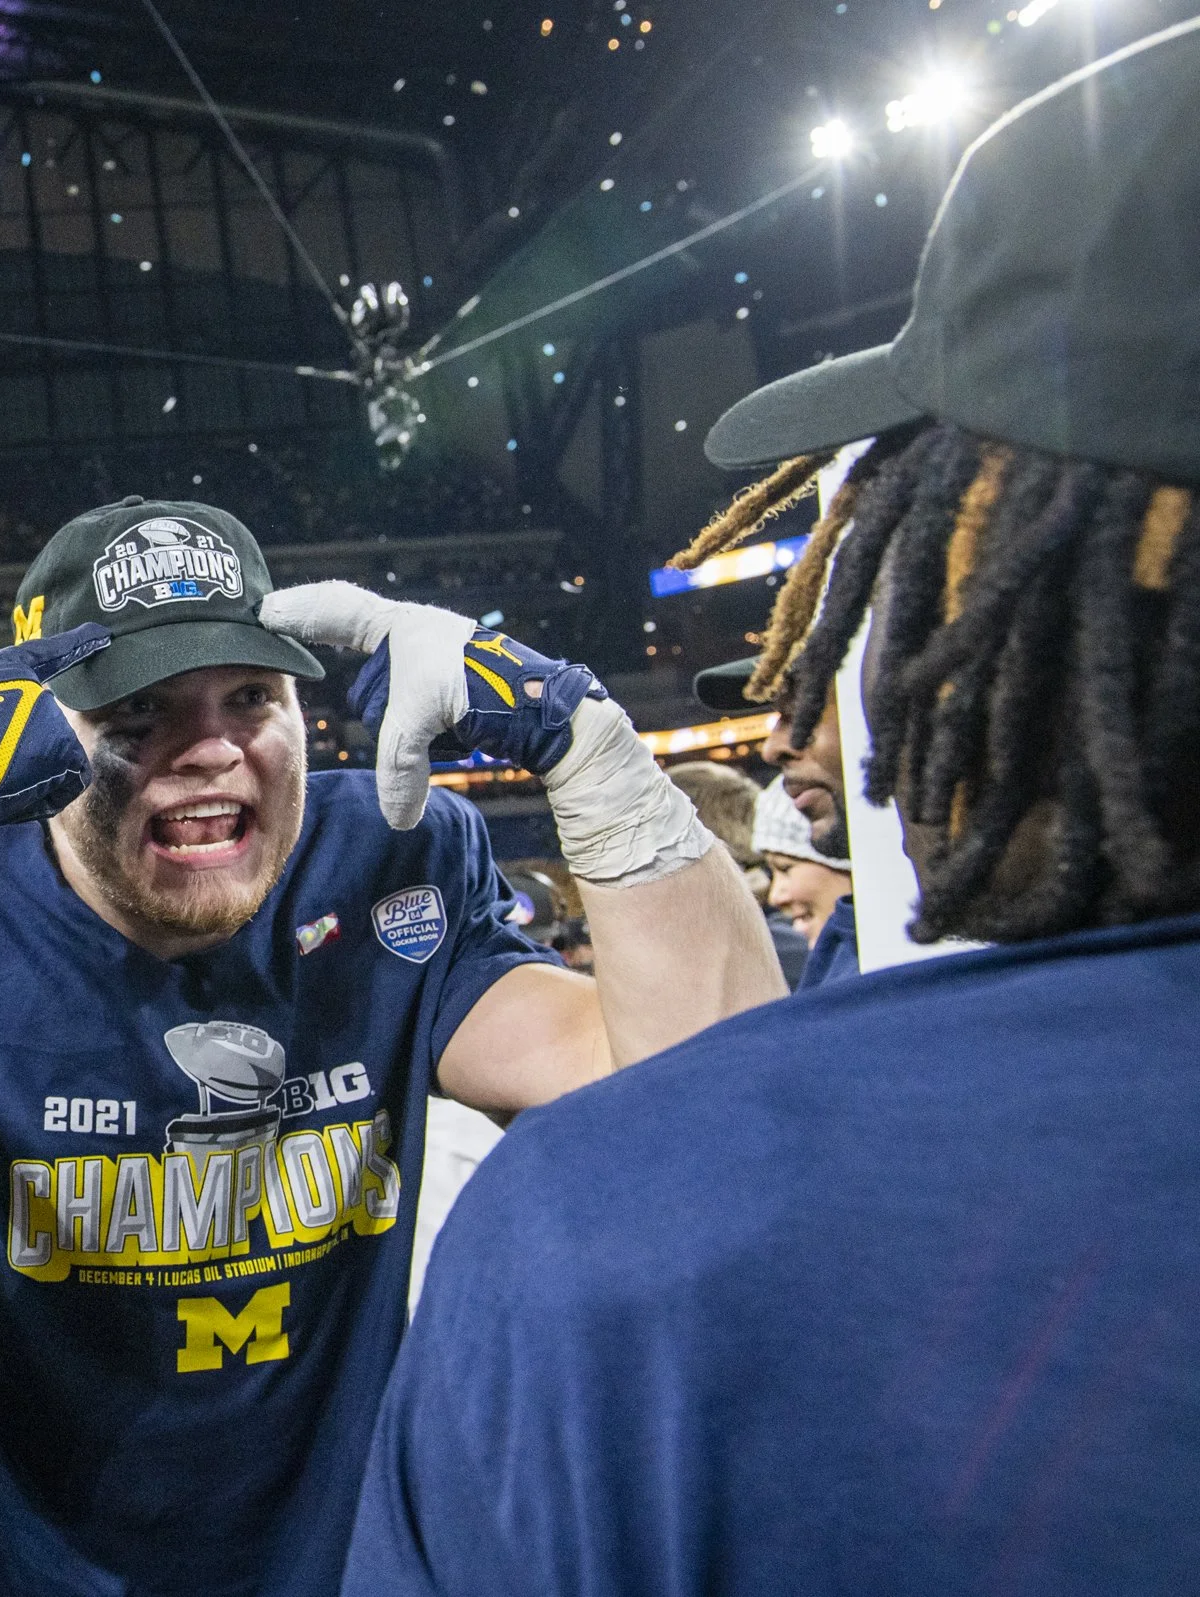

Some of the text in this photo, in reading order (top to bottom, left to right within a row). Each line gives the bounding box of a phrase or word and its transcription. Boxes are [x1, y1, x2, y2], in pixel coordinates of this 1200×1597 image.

[115, 535, 214, 559] 20 21
[98, 548, 239, 608] CHAMPIONS
[384, 891, 433, 926] Blue
[387, 922, 439, 941] OFFICIAL
[392, 934, 439, 947] LOCKER ROOM
[44, 1096, 137, 1135] 2021
[8, 1109, 401, 1275] CHAMPIONS
[79, 1269, 142, 1286] DECEMBER
[145, 1271, 155, 1286] 4
[164, 1269, 201, 1286] LUCAS
[204, 1265, 222, 1281] OIL
[225, 1255, 277, 1279] STADIUM
[177, 1282, 291, 1373] M
